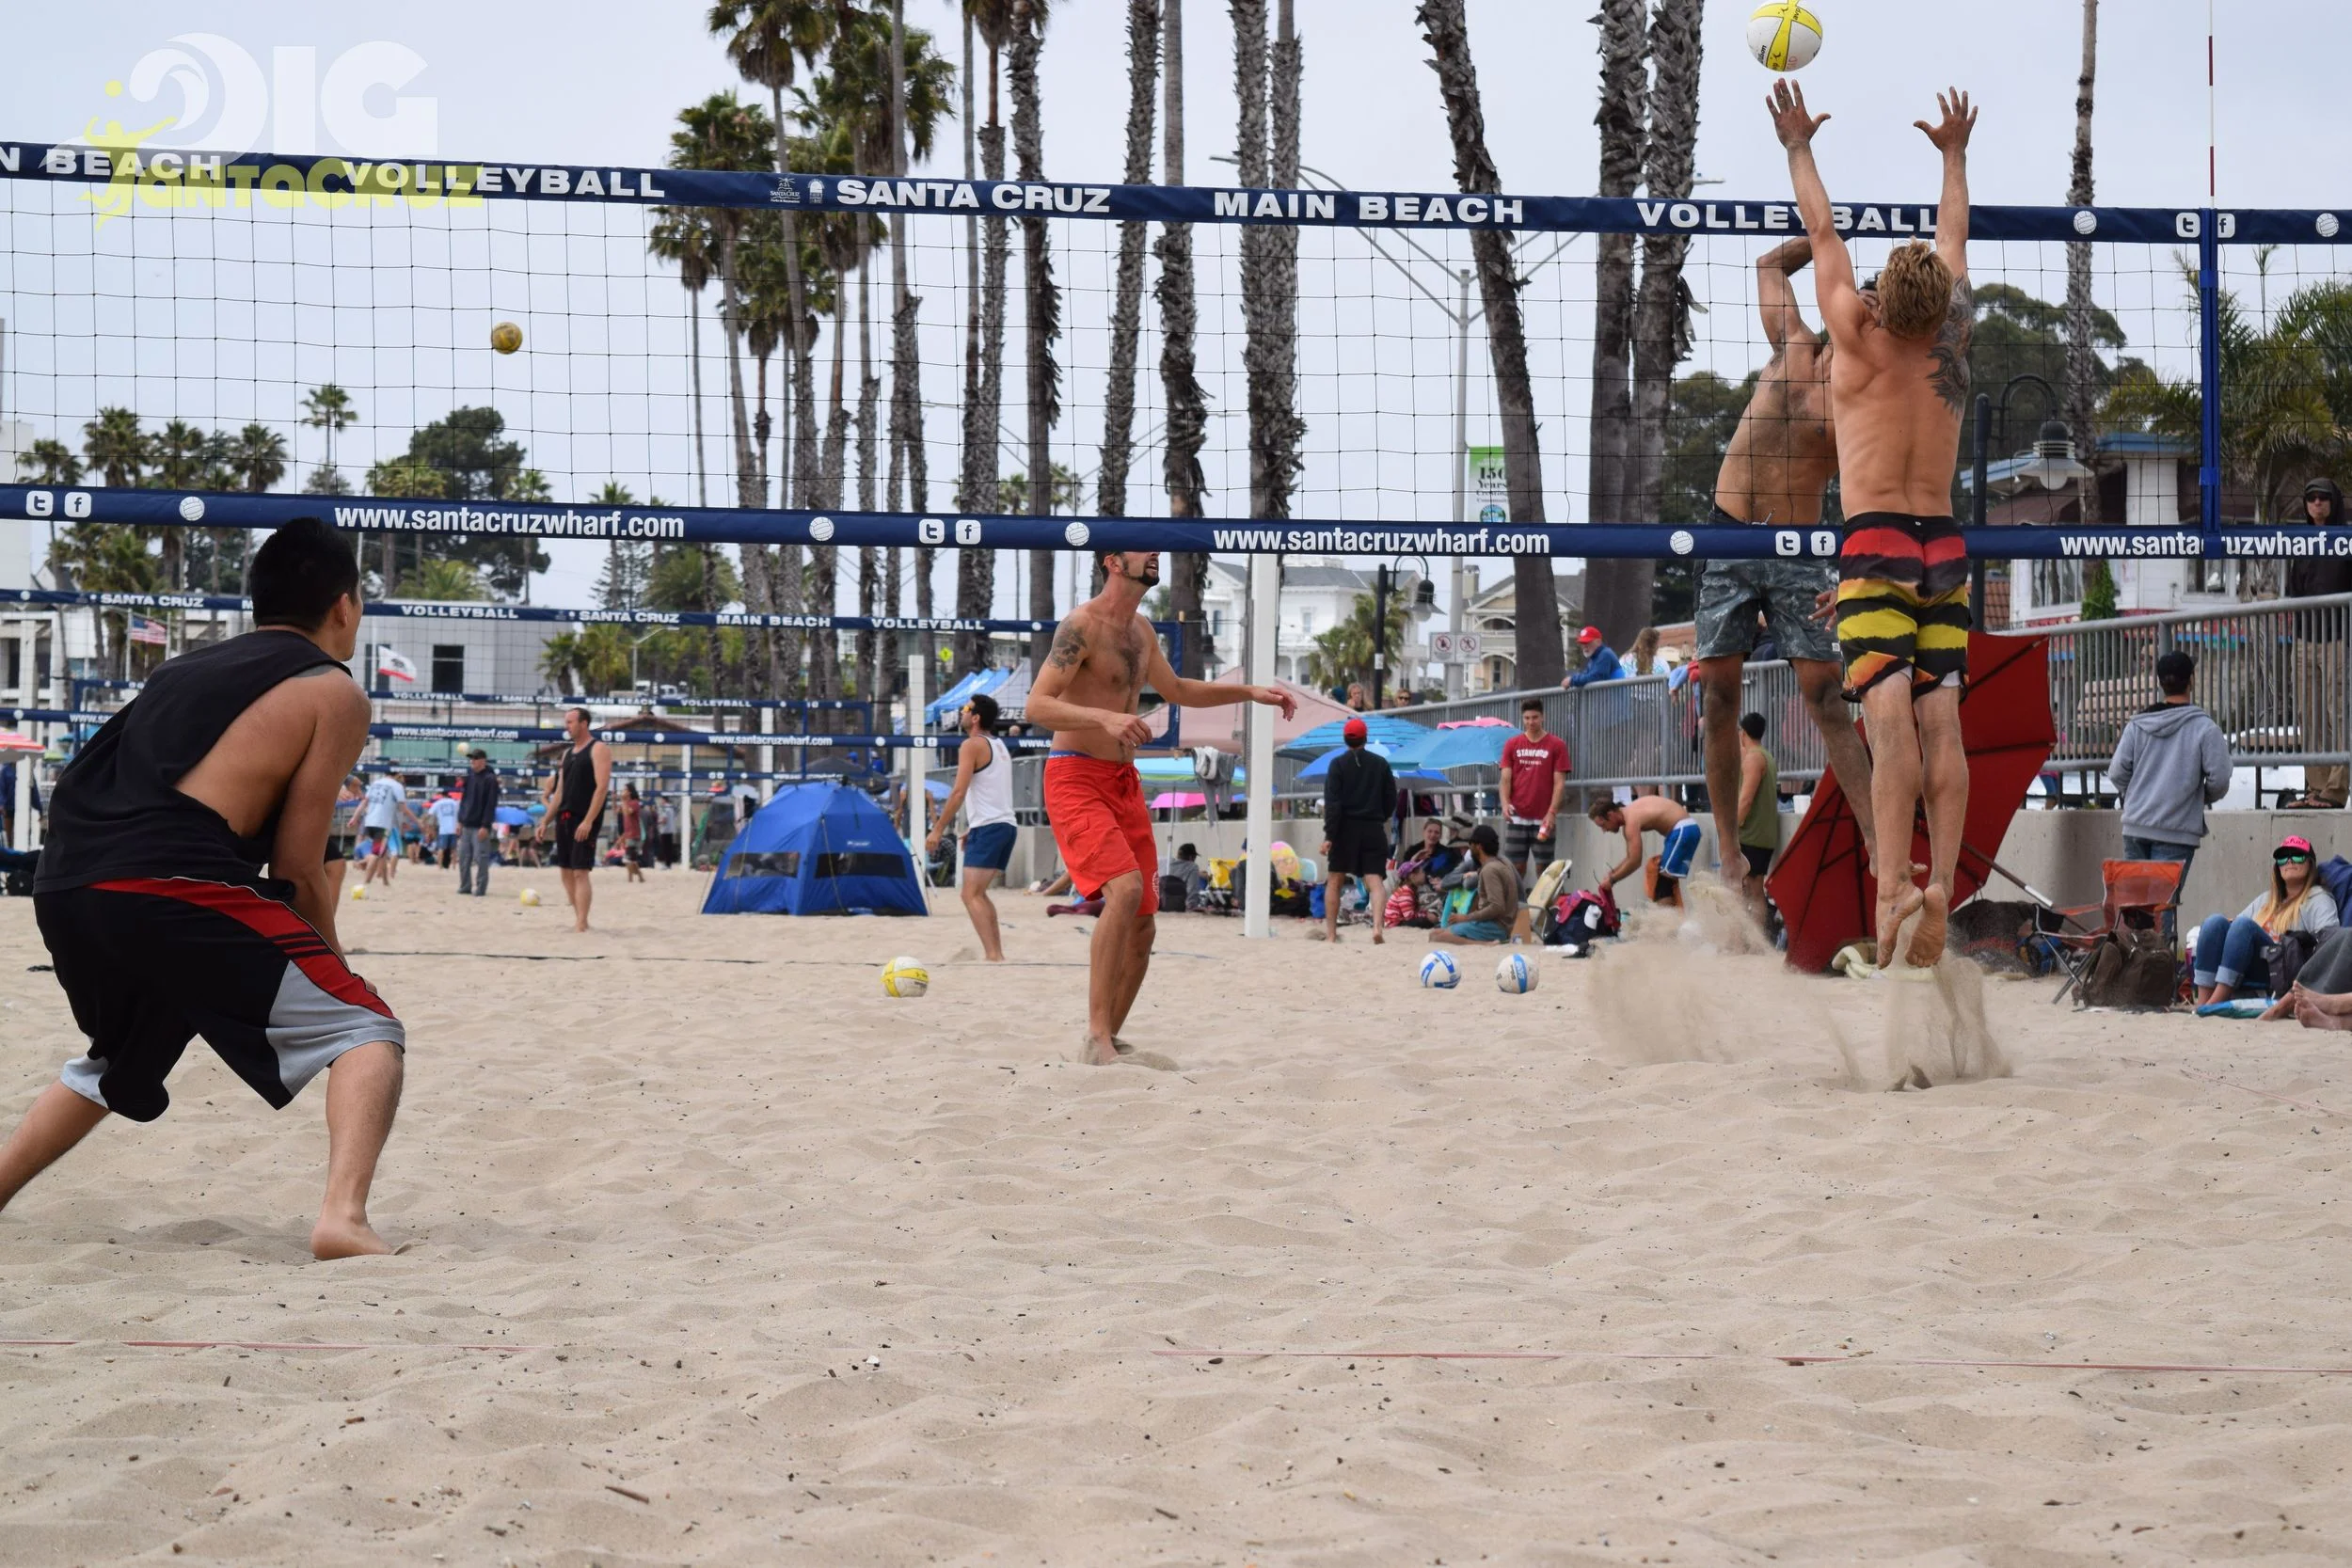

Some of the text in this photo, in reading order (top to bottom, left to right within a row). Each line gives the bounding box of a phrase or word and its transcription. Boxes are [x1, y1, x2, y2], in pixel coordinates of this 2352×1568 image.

[46, 148, 221, 181] BEACH
[342, 162, 665, 198] VOLLEYBALL
[836, 179, 979, 209] SANTA
[992, 183, 1111, 214] CRUZ
[1214, 192, 1524, 224] MAIN BEACH
[334, 506, 685, 538] www.santacruzwharf.com
[1214, 527, 1550, 554] www.santacruzwharf.com
[100, 594, 155, 607] SANTA
[158, 596, 204, 608] CRUZ
[401, 605, 519, 619] VOLLEYBALL
[579, 610, 680, 624] SANTA CRUZ
[716, 614, 831, 627] MAIN BEACH
[871, 618, 985, 630] VOLLEYBALL
[681, 699, 752, 707] VOLLEYBALL
[392, 726, 518, 739] www.santacruzwharf.com
[707, 735, 834, 746] www.santacruzwharf.com
